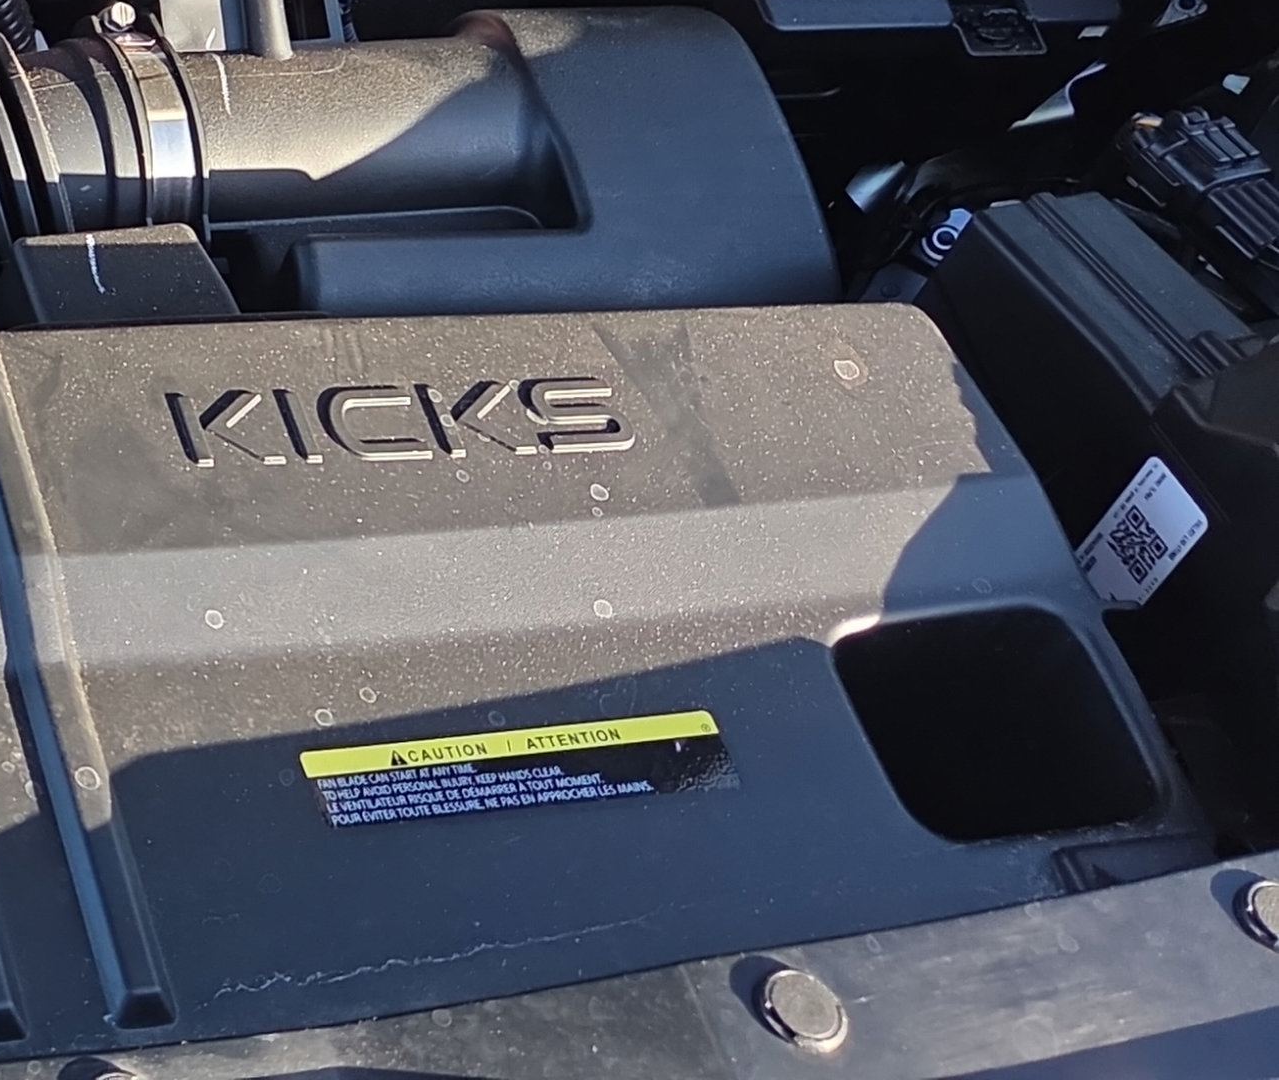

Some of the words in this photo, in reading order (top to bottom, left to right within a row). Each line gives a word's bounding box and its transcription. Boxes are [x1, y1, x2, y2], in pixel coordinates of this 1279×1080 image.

[163, 376, 636, 468] KICKS
[407, 743, 488, 762] CAUTION
[526, 728, 621, 750] ATTENTION
[317, 777, 337, 790] FAN
[337, 775, 368, 787] BLADE
[368, 773, 390, 785] CAN
[390, 770, 418, 783] START
[419, 768, 432, 779] AT
[432, 766, 451, 778] ANY
[322, 790, 337, 802] TO
[337, 788, 360, 800] HELP
[363, 785, 391, 797] AVOID
[393, 781, 441, 794] PERSONAL
[475, 773, 498, 785] KEEP
[499, 769, 532, 782] HANDS
[326, 803, 340, 814] LE
[341, 795, 408, 811] VENTILATEUR
[408, 791, 444, 804] RISQUE
[445, 789, 461, 800] DE
[527, 777, 555, 790] TOUT
[331, 813, 362, 827] POUR
[398, 804, 432, 818] TOUTE
[485, 797, 501, 810] NE
[501, 794, 521, 807] PAS
[521, 792, 537, 804] EN
[537, 787, 599, 803] APPROCHER
[598, 784, 617, 797] LES
